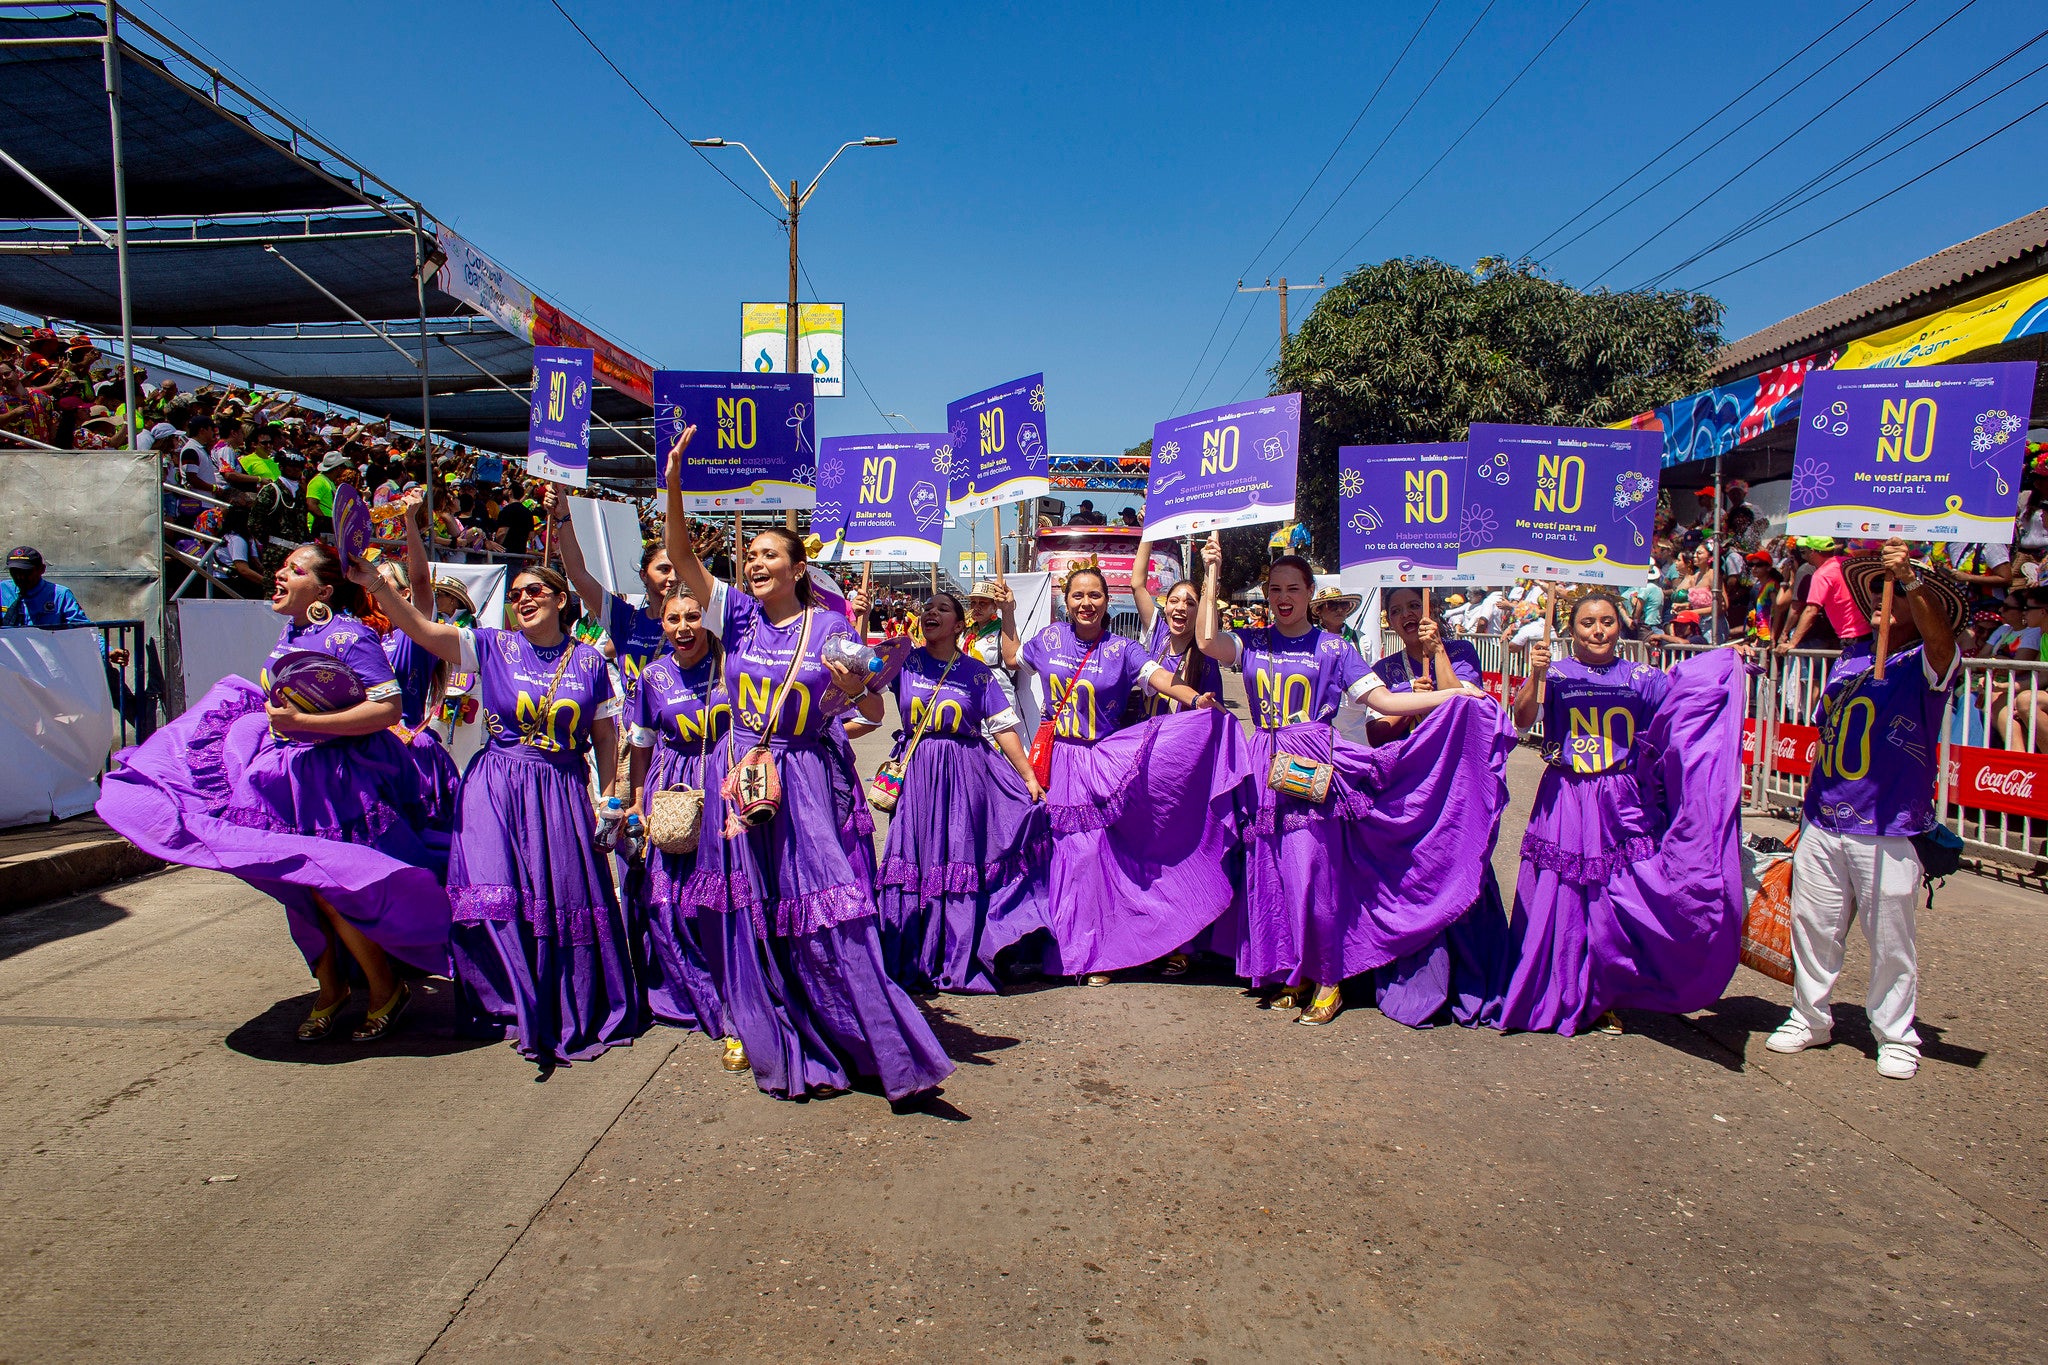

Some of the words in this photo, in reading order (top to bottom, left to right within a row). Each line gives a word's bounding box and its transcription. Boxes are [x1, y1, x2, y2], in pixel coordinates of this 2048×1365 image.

[687, 457, 728, 466] Disfrutar
[728, 457, 741, 465] del
[980, 459, 995, 470] Bailar
[995, 457, 1008, 466] sola
[707, 466, 729, 475] libres
[730, 468, 735, 476] y
[736, 466, 769, 476] seguras.
[1854, 472, 1872, 482] Me
[1873, 472, 1903, 482] vestí
[1903, 474, 1932, 484] para
[1934, 473, 1951, 483] mí
[1180, 483, 1215, 495] Sentirme
[1216, 475, 1258, 488] respetada
[1872, 485, 1886, 493] no
[1888, 485, 1913, 495] para
[1915, 484, 1927, 494] ti.
[1174, 495, 1185, 504] los
[1185, 492, 1214, 502] eventos
[1214, 488, 1227, 497] del
[855, 511, 877, 519] Bailar
[858, 519, 867, 527] mi
[867, 518, 897, 527] decisión.
[1515, 519, 1531, 528] Me
[1533, 521, 1557, 530] vestí
[1558, 523, 1582, 534] para
[1583, 523, 1597, 533] mí
[1395, 532, 1423, 540] Haber
[1424, 532, 1458, 540] tomado
[1545, 533, 1567, 541] para
[1568, 533, 1578, 542] ti.
[1377, 542, 1386, 550] te
[1387, 542, 1398, 550] da
[1400, 541, 1435, 550] derecho
